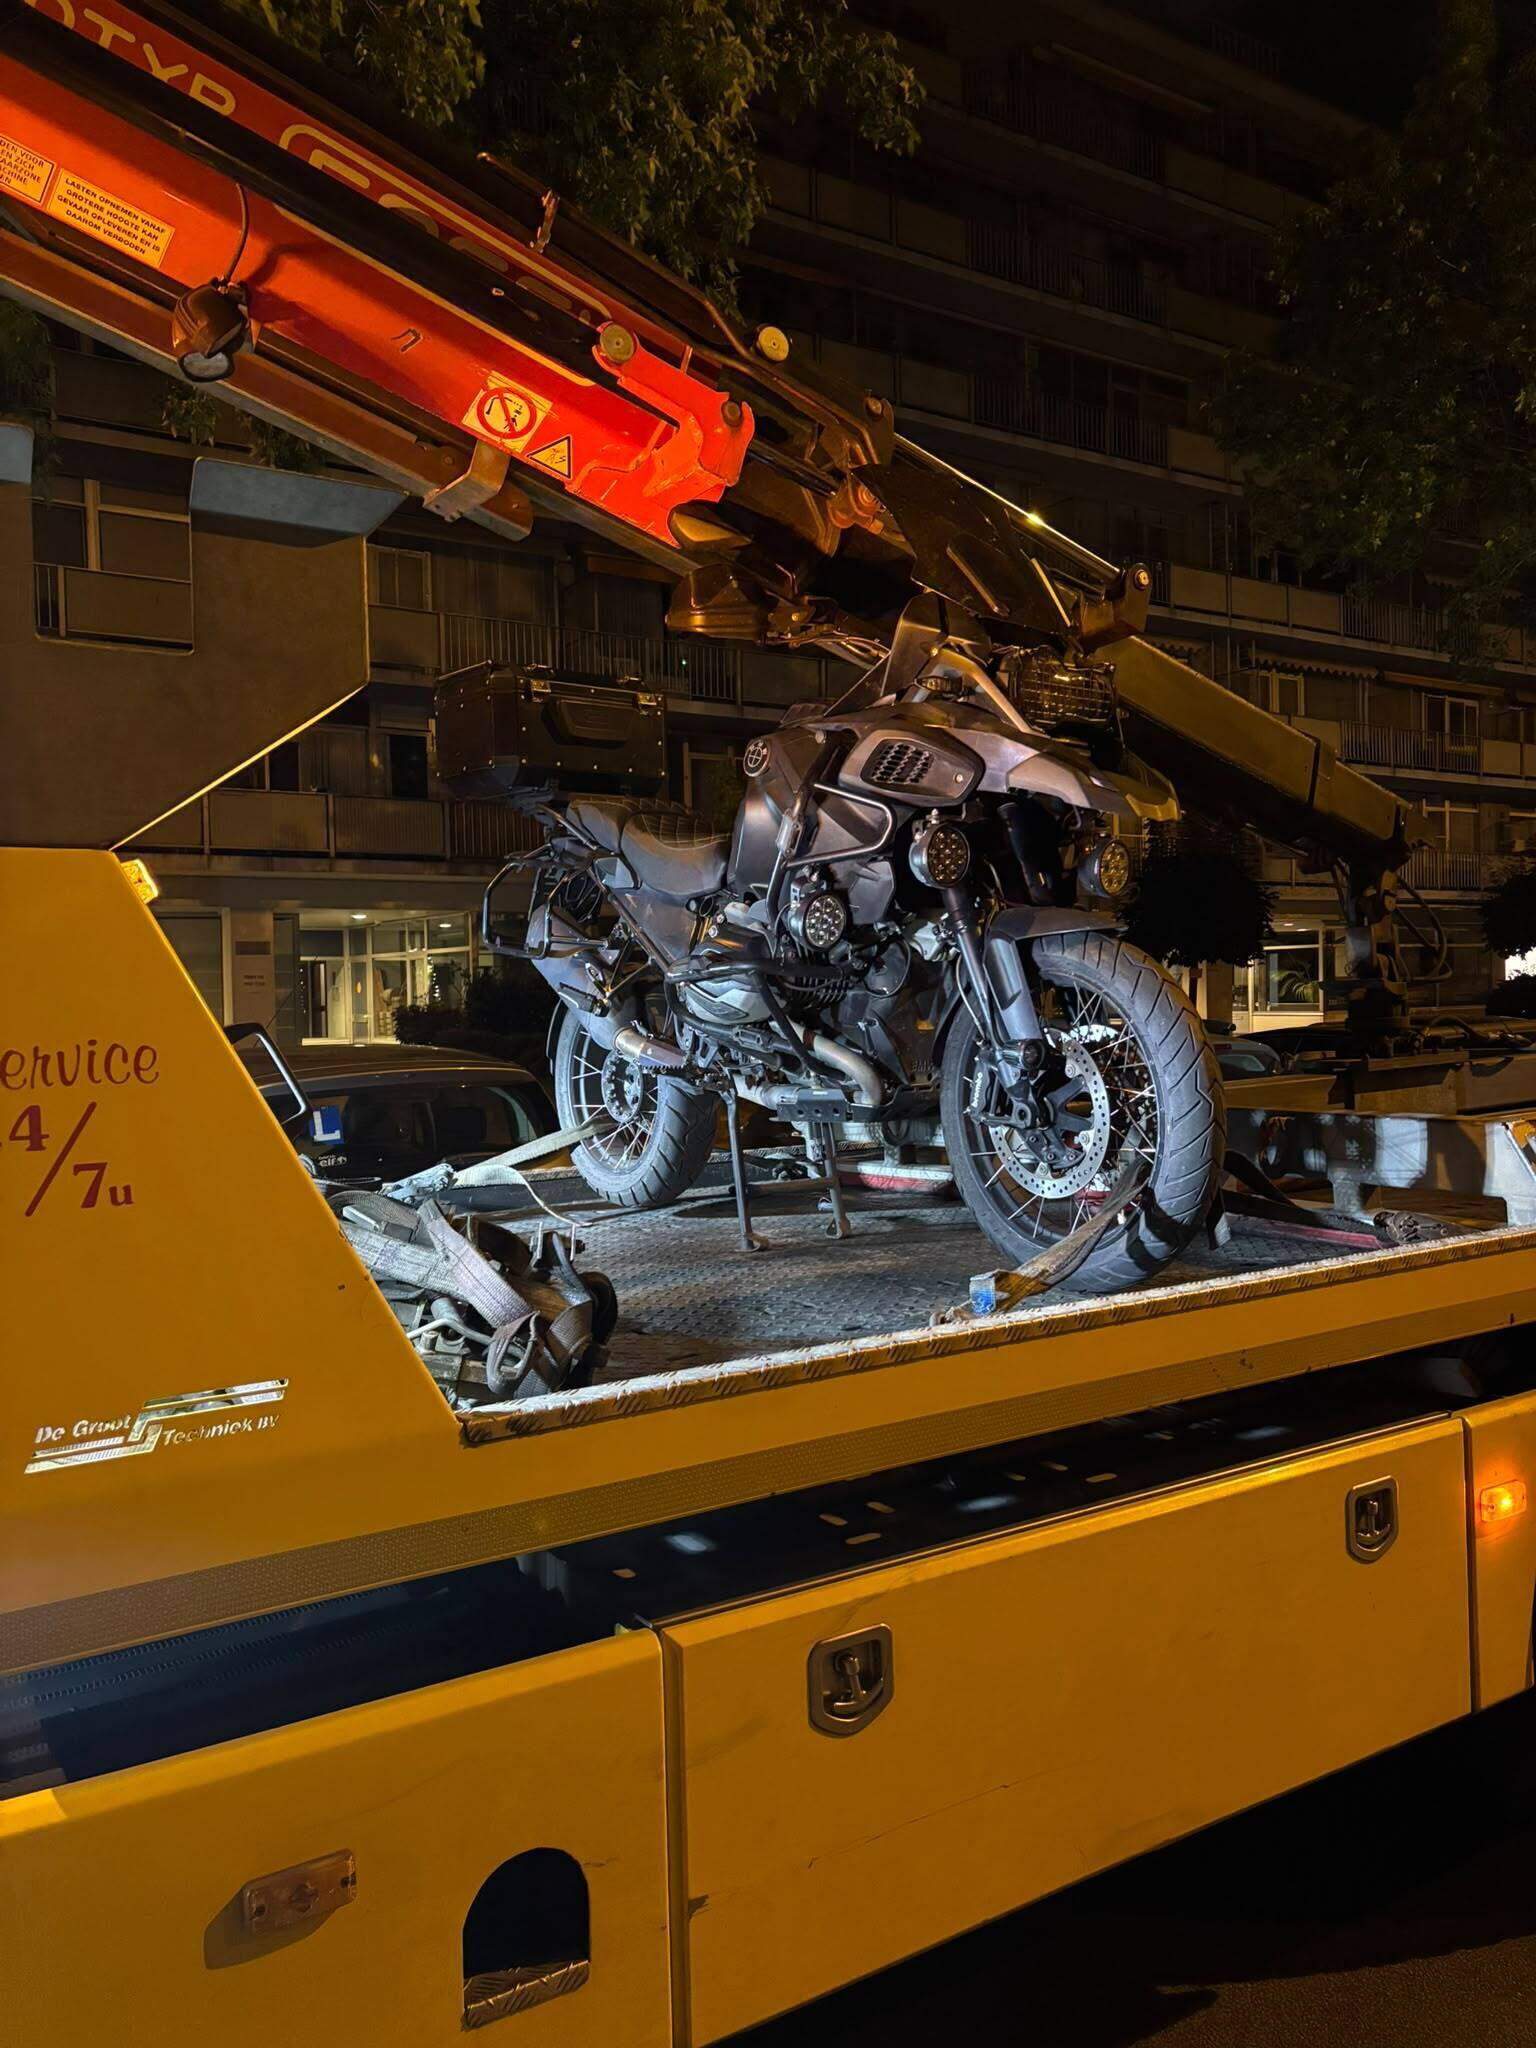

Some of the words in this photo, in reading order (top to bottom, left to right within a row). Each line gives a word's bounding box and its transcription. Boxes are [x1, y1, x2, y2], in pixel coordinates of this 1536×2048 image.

[15, 156, 35, 171] ZICH
[20, 150, 45, 168] VOOR
[57, 194, 90, 215] GEVAAR
[91, 212, 139, 241] OPLEVEREN
[139, 238, 152, 248] EN
[152, 244, 161, 252] IS
[65, 177, 98, 198] LASTEN
[98, 195, 139, 220] OPNEMEN
[140, 217, 166, 234] VANAF
[66, 188, 105, 212] GROTERE
[107, 210, 140, 232] HOOGTE
[141, 229, 159, 241] KAN
[65, 209, 101, 232] DAAROM
[103, 227, 146, 255] VERBODEN
[313, 1110, 341, 1142] L
[0, 1101, 134, 1217] 4/7u
[34, 1425, 66, 1444] De
[72, 1414, 132, 1438] Groot
[162, 1417, 253, 1446] Techniek
